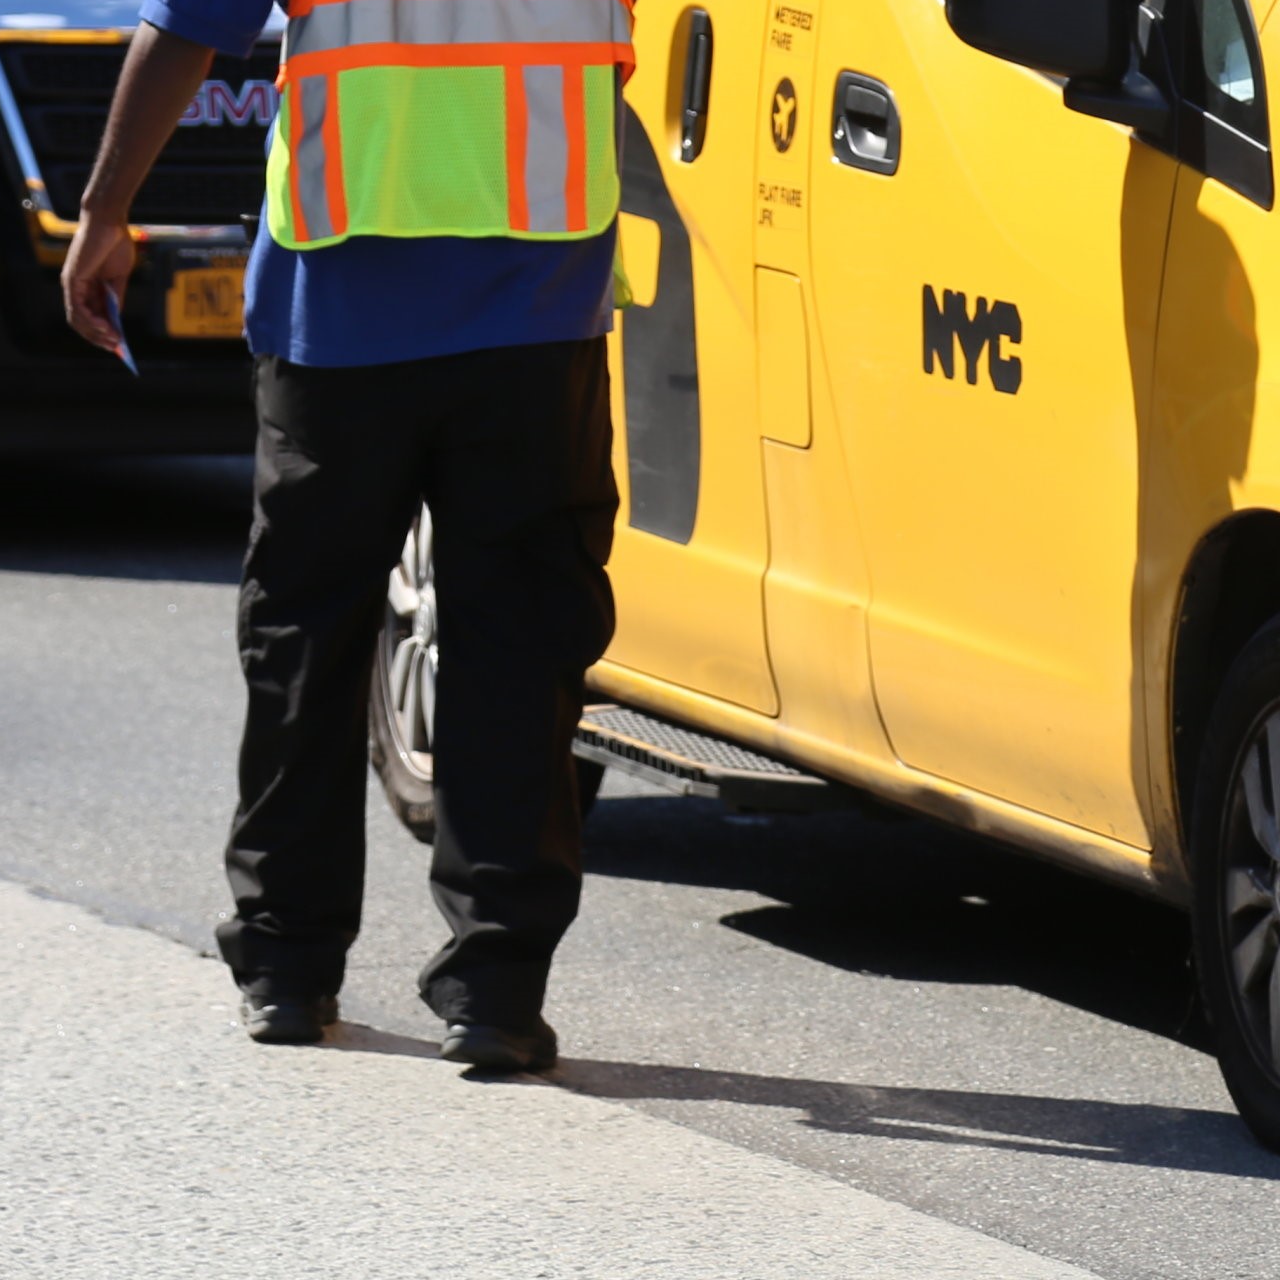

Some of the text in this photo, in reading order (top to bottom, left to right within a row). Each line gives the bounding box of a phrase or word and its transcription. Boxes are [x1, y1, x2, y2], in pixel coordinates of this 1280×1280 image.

[775, 6, 813, 31] METERED
[771, 29, 792, 51] FARE
[759, 183, 802, 208] FLAT FARE
[923, 283, 1022, 395] NYC
